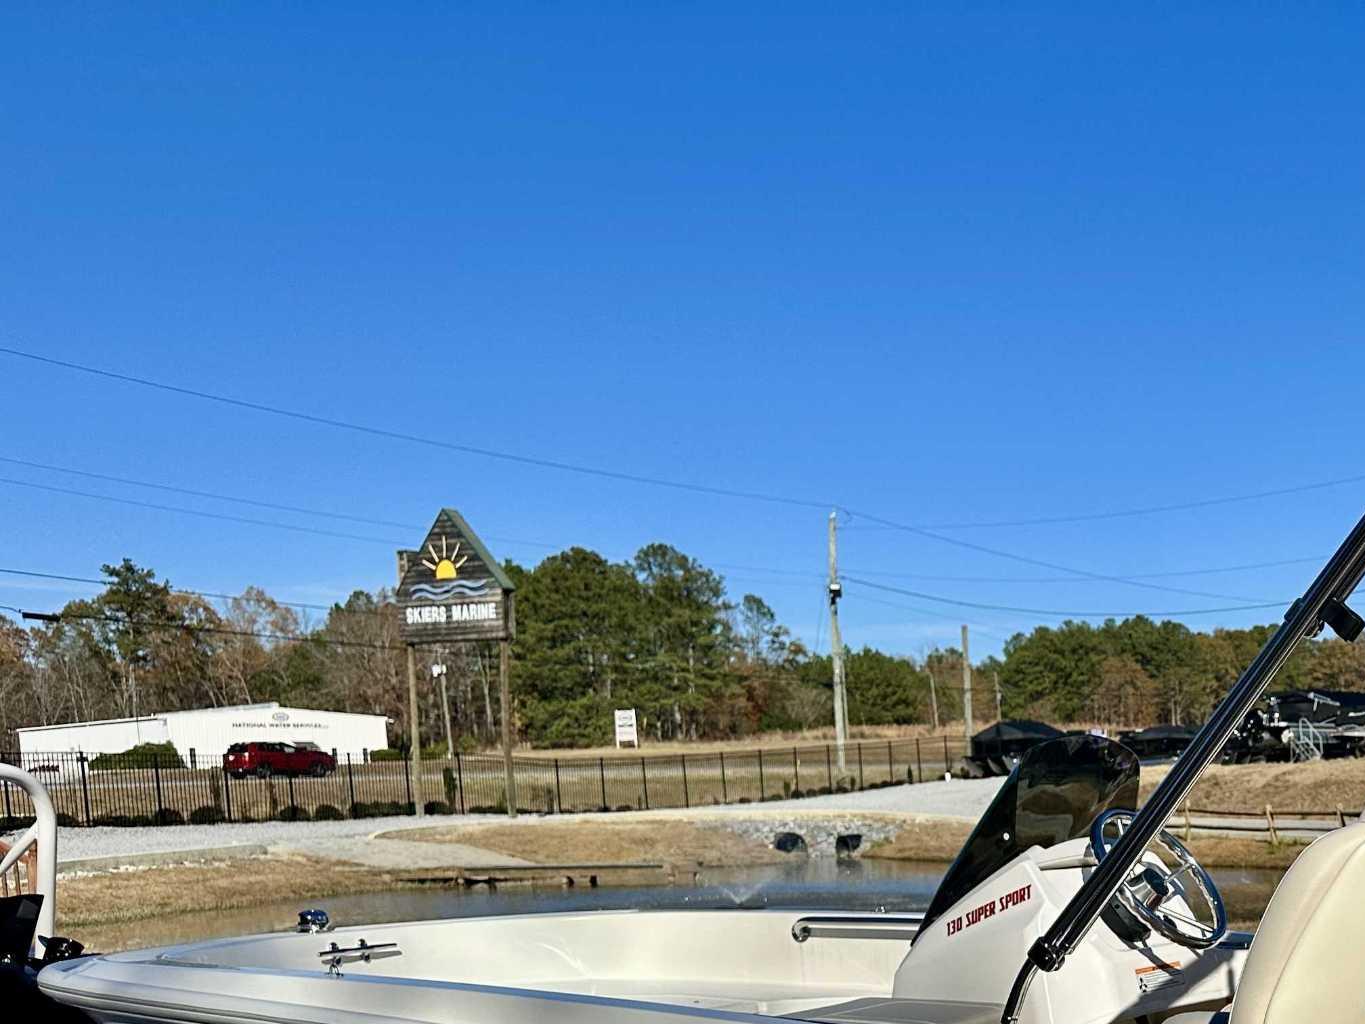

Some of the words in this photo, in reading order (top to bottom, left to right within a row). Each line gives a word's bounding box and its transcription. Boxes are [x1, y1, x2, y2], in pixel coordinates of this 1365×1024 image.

[405, 605, 447, 624] SKIERS
[451, 602, 497, 621] MARINE
[946, 916, 963, 937] 130
[965, 900, 996, 928] SUPER
[999, 884, 1032, 912] SPORT
